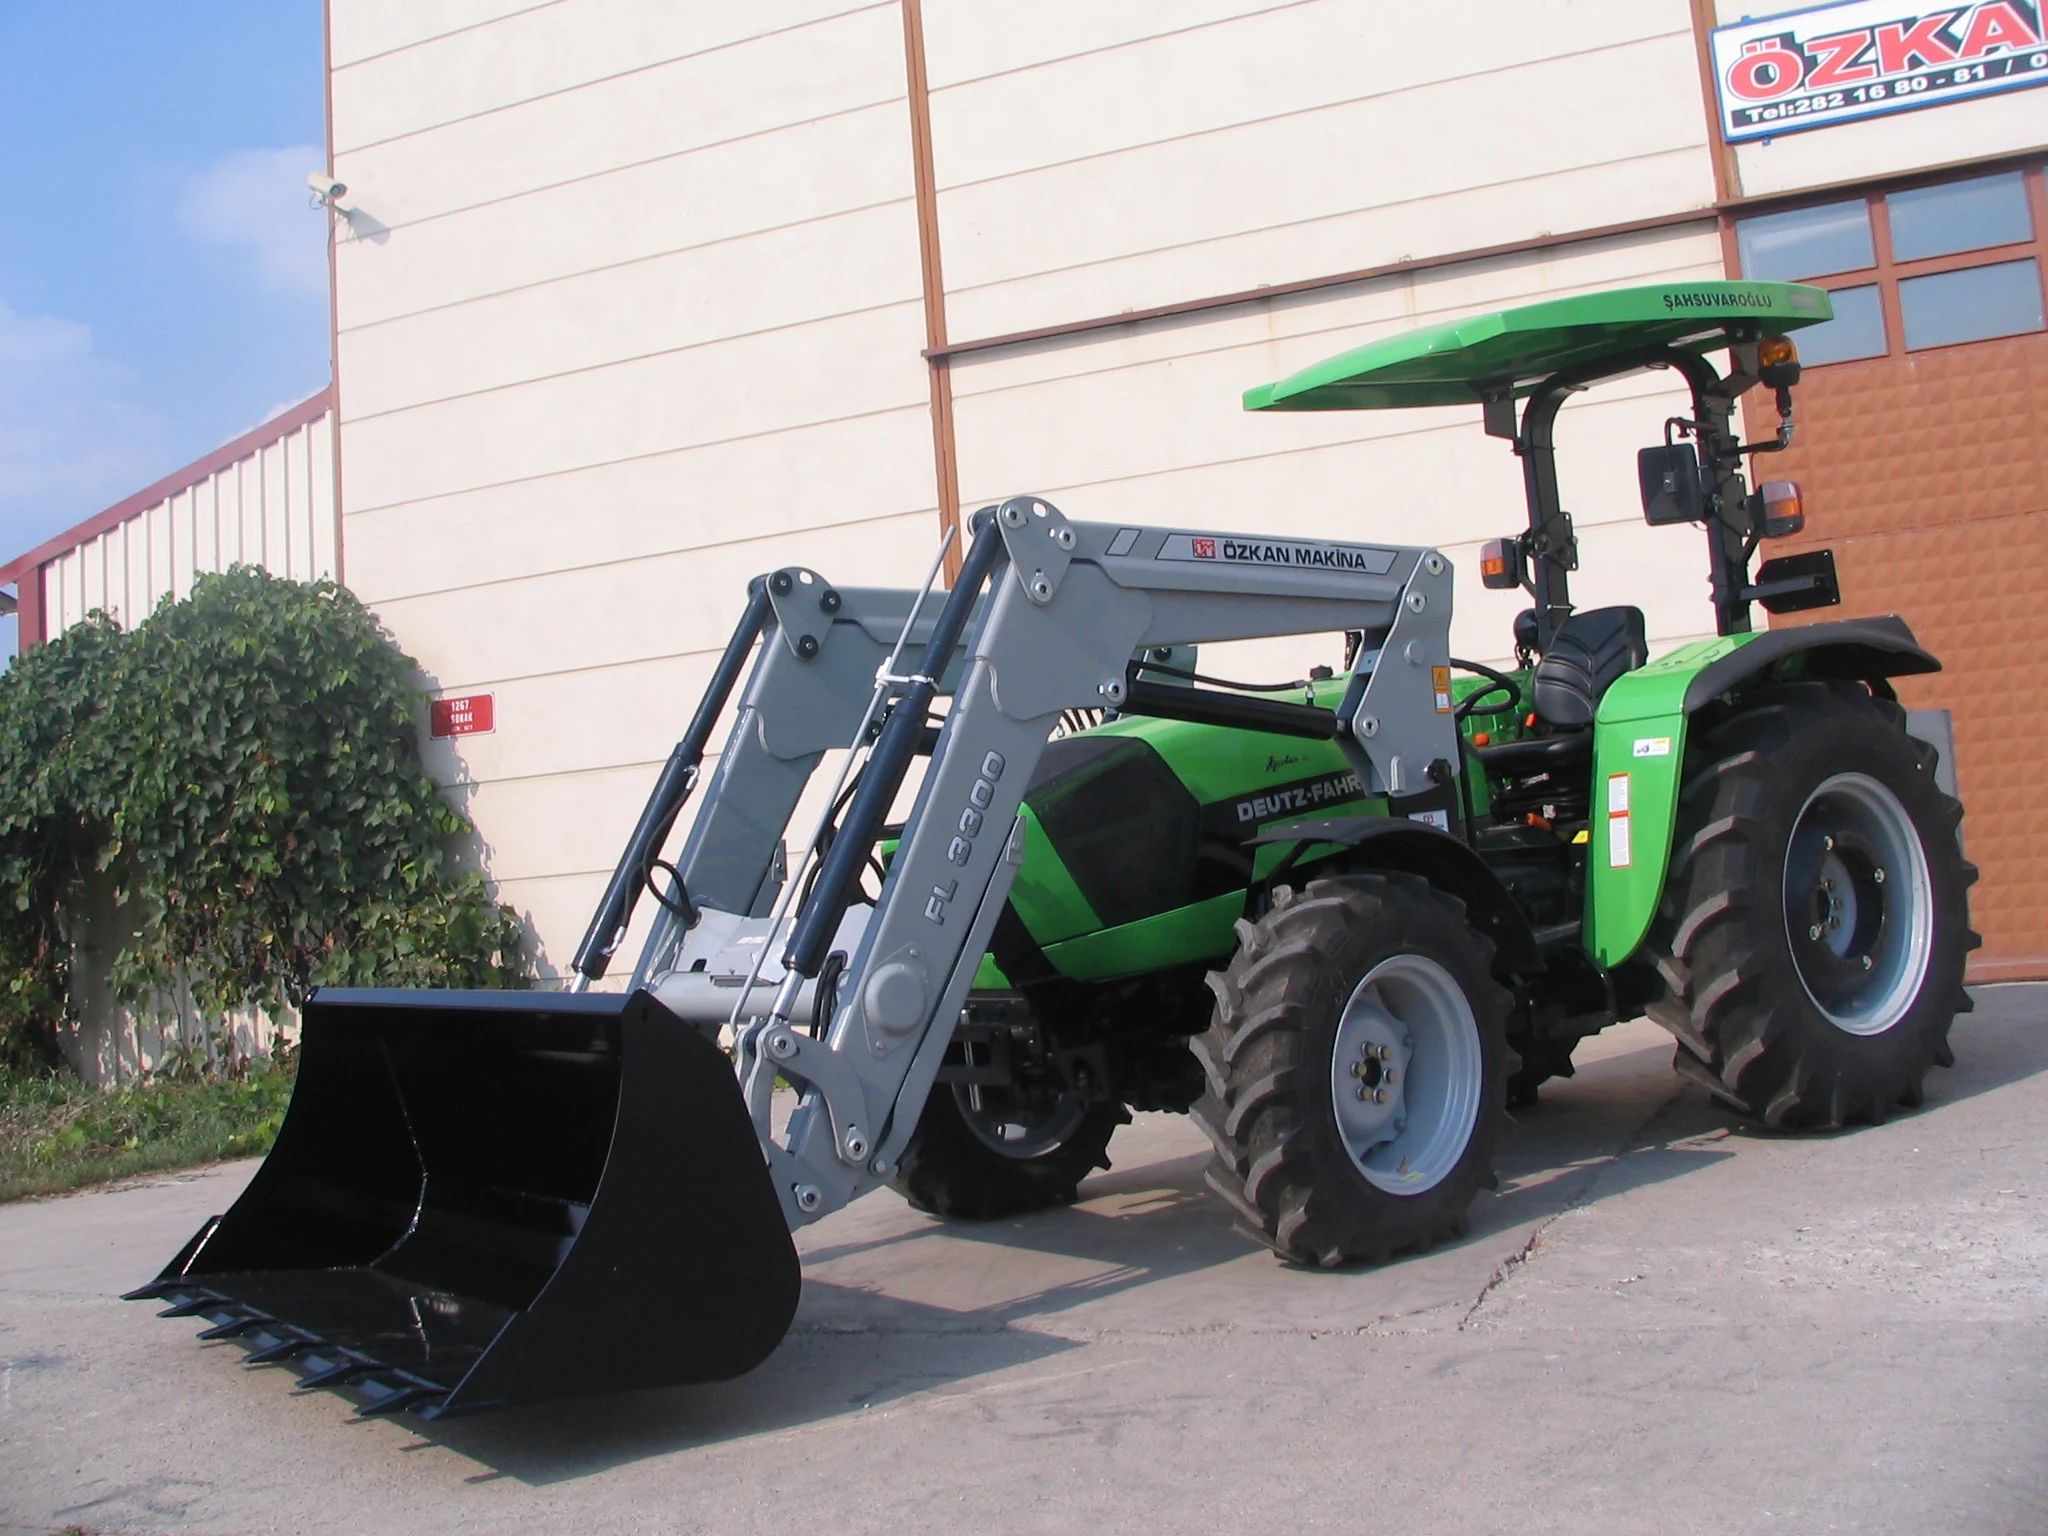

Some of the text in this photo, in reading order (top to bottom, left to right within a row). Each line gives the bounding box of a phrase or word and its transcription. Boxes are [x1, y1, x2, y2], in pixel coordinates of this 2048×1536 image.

[1726, 0, 2048, 102] ÖZKA
[1744, 92, 1845, 123] Tel:282
[1853, 84, 1887, 102] 16
[1893, 76, 1928, 95] 80
[1953, 64, 1986, 83] 81
[2004, 58, 2014, 75] /
[1662, 292, 1773, 312] ŞAHSUVAROĞLU
[1223, 540, 1290, 563] ÖZKAN
[1295, 548, 1367, 570] MAKİNA
[1236, 774, 1362, 822] DEUTZ-FAHR
[923, 749, 1006, 926] FL 3300
